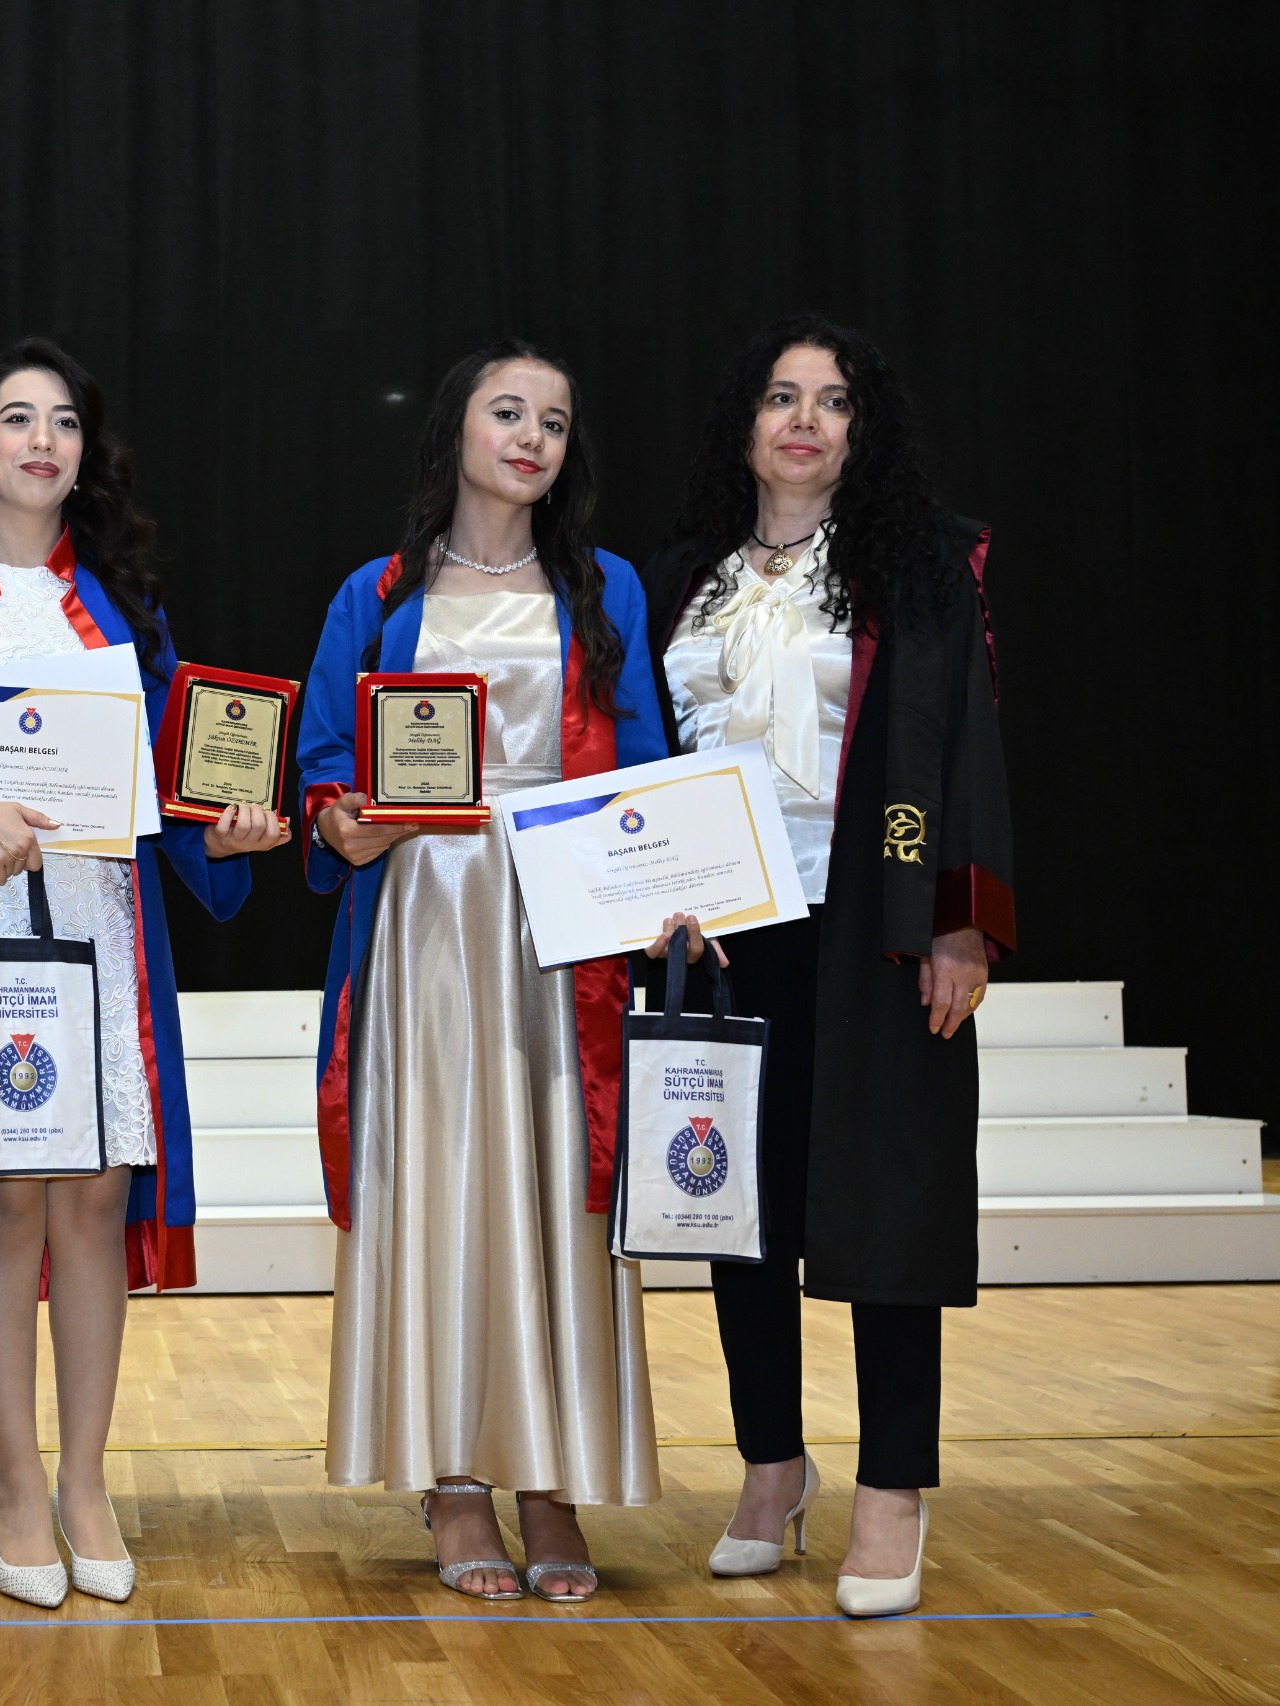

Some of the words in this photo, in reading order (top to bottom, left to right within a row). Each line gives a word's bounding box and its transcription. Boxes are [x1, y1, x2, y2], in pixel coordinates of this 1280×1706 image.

[0, 745, 26, 754] BAŞARI
[28, 747, 58, 756] BELGESİ
[607, 846, 637, 857] BAŞARI
[637, 838, 670, 852] BELGESİ
[15, 977, 28, 985] T.C.
[28, 994, 57, 1005] İMAM
[665, 1067, 723, 1078] KAHRAMANMARAŞ
[664, 1075, 704, 1089] SÜTÇÜ
[707, 1076, 724, 1089] İMAM
[663, 1088, 725, 1102] ÜNİVERSİTESİ
[675, 1213, 692, 1221] (0344)
